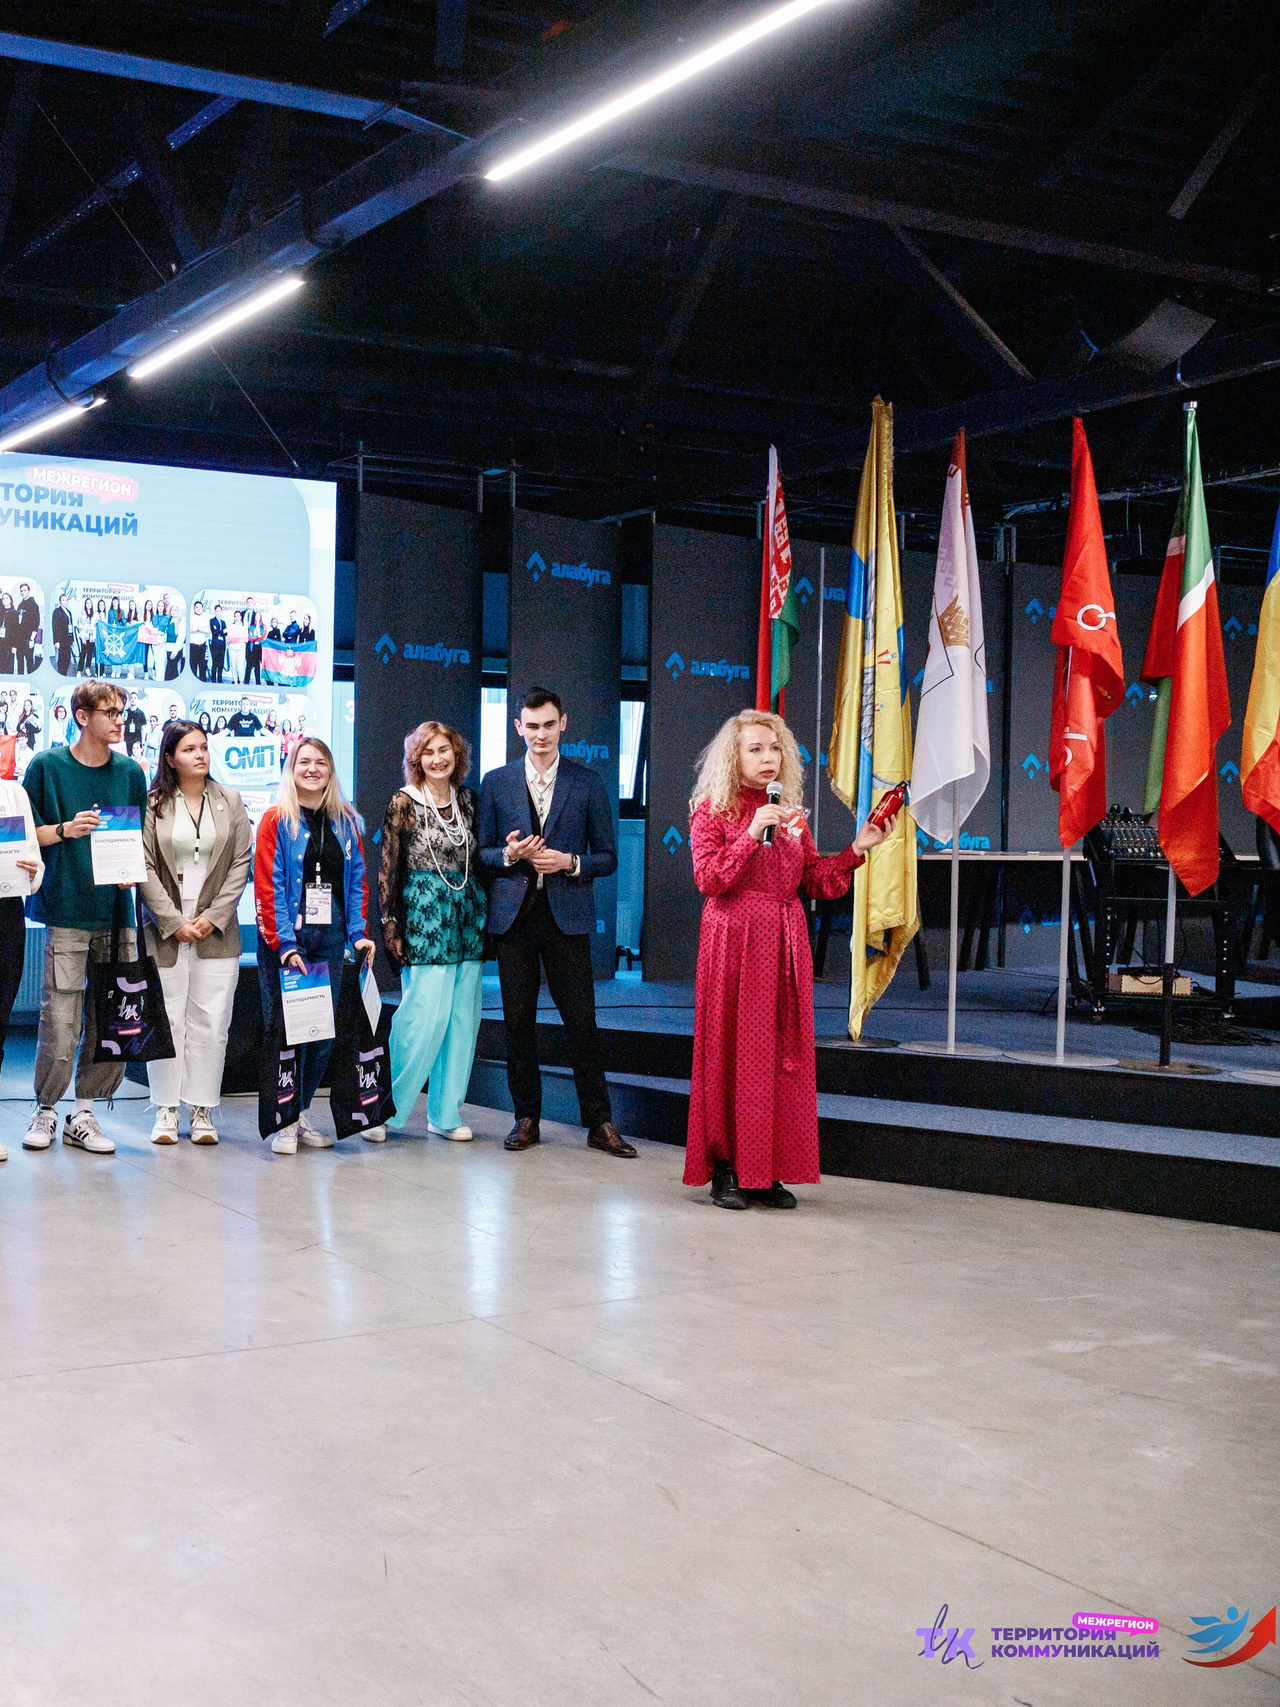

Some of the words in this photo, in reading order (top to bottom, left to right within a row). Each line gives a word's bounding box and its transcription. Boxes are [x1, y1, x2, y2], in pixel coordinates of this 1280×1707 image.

[33, 467, 132, 496] МЕЖРЕГИОН
[551, 561, 611, 587] алабуга
[403, 642, 470, 668] алабуга
[690, 659, 750, 684] алабуга
[561, 739, 610, 763] лабуга
[286, 994, 326, 1004] БЛАГОДАРНОСТЬ
